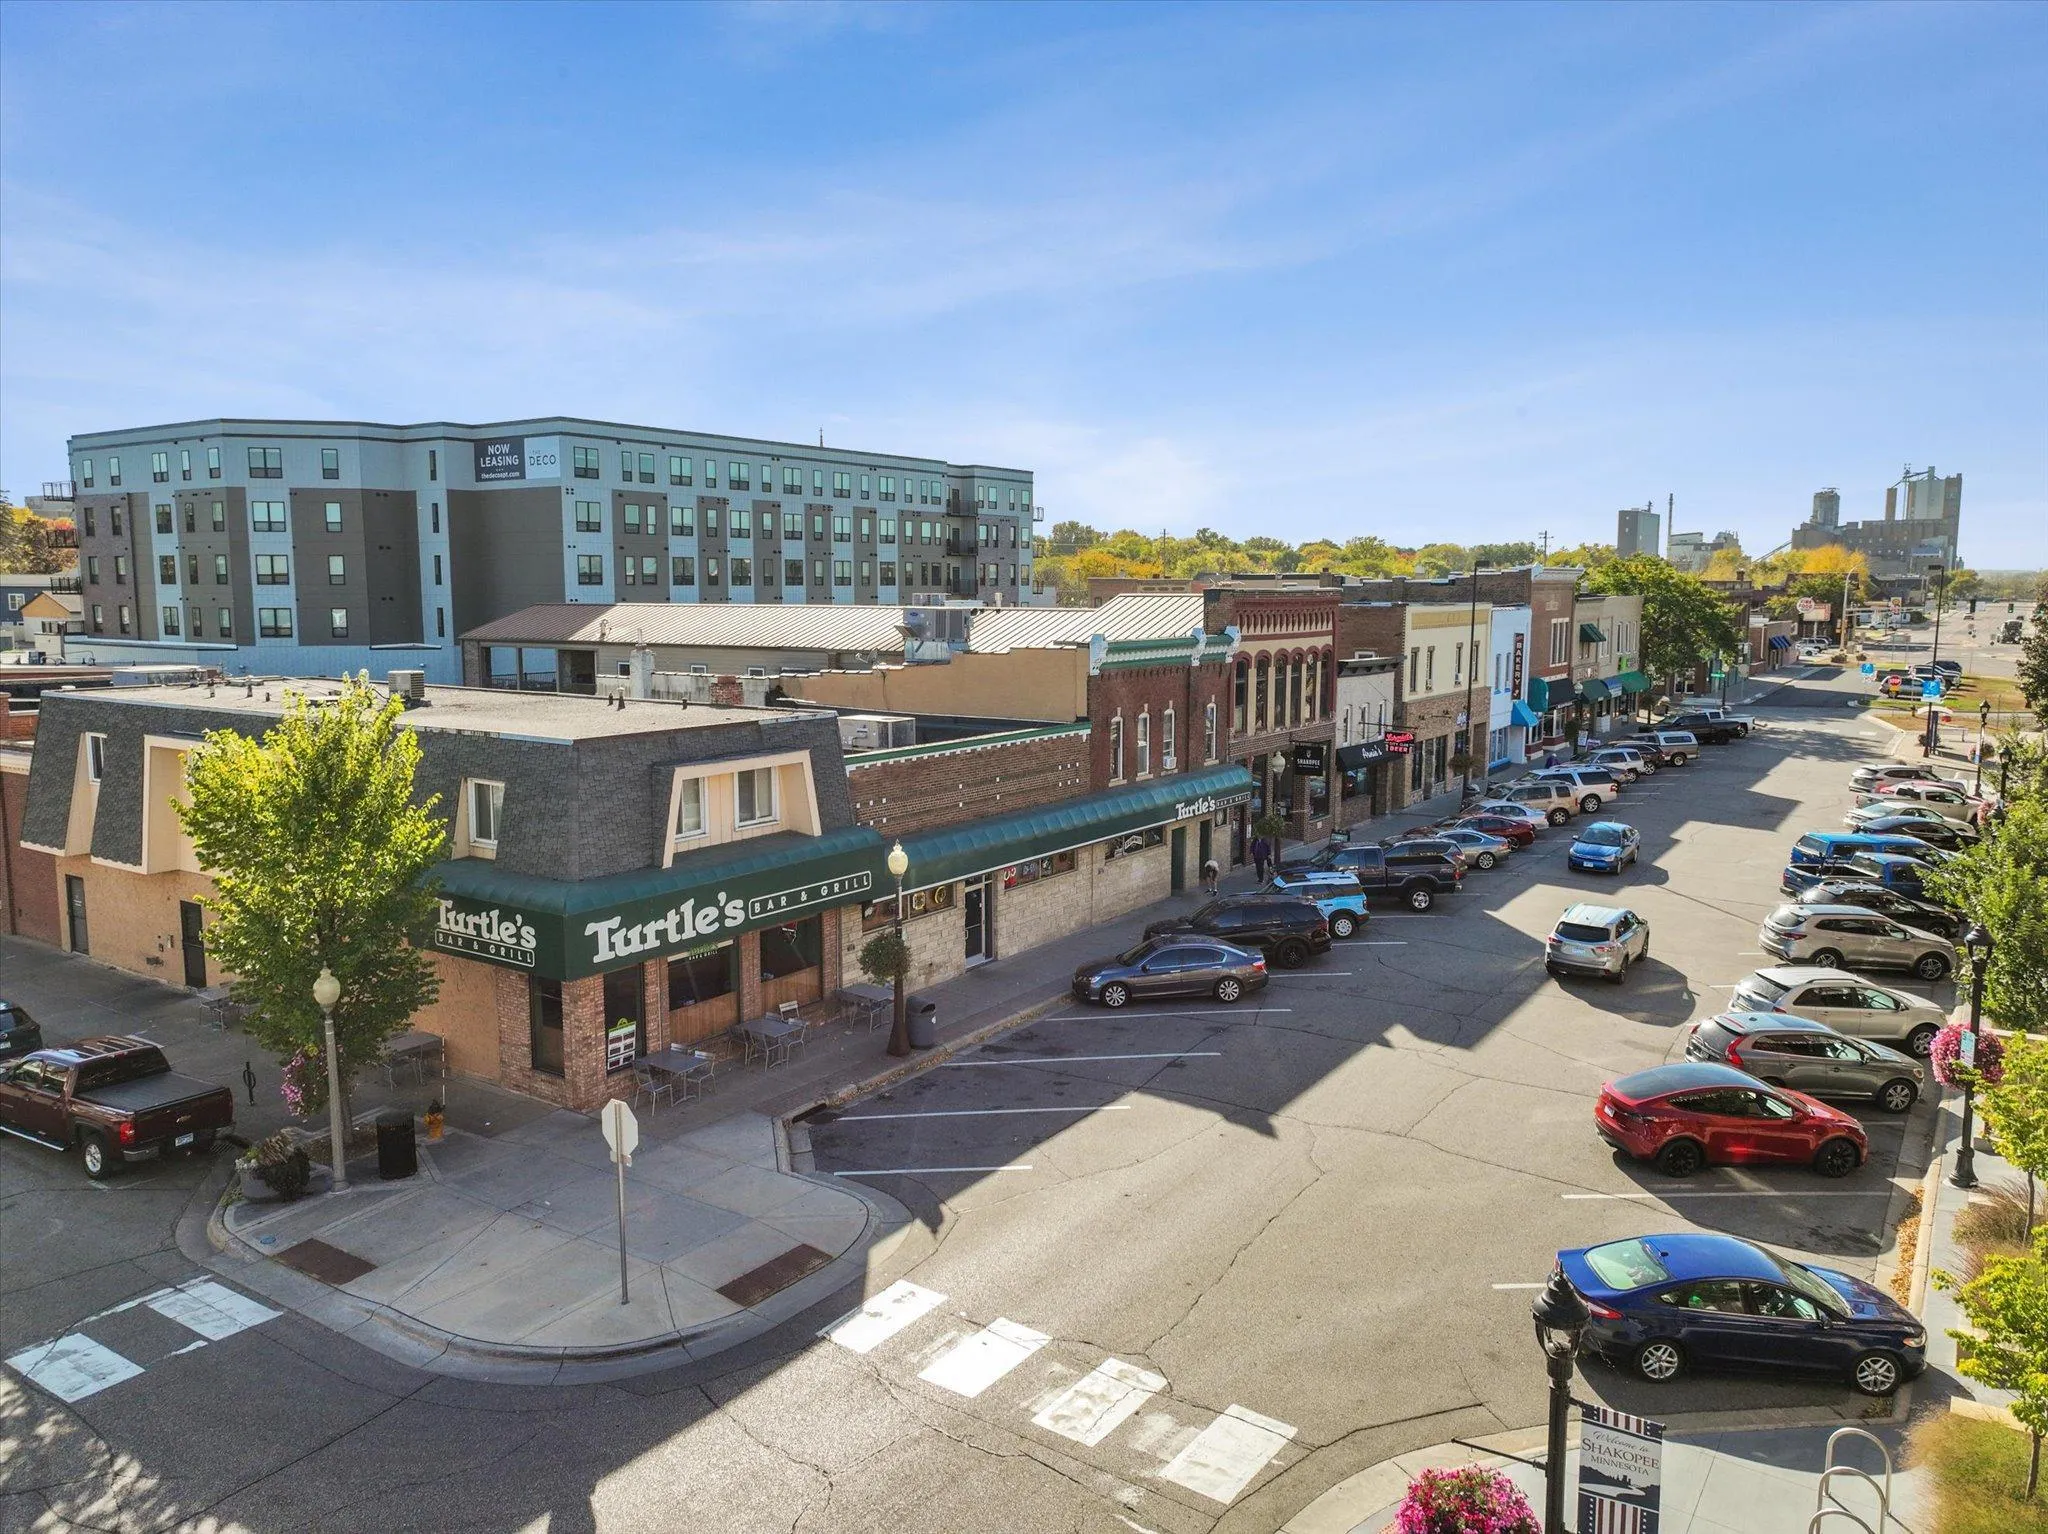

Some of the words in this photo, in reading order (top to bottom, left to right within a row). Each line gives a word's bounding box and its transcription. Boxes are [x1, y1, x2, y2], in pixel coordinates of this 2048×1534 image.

[480, 455, 520, 468] LEASING
[487, 444, 510, 456] NOW
[529, 454, 557, 466] DECO
[1514, 642, 1522, 685] BAKERY
[1297, 758, 1321, 766] SHAKOPEE
[1175, 795, 1216, 821] Turtle's
[434, 897, 537, 949] Turtle's
[584, 891, 745, 964] Turtle's
[753, 896, 787, 914] BAR
[800, 890, 808, 902] &
[820, 874, 869, 896] GRILL
[439, 933, 463, 947] BAR
[473, 940, 479, 950] &
[489, 944, 532, 963] GRILL
[1592, 1430, 1637, 1450] Welcome
[1581, 1437, 1660, 1470] SHAKOPEE
[1590, 1455, 1650, 1476] MINNESOTA
